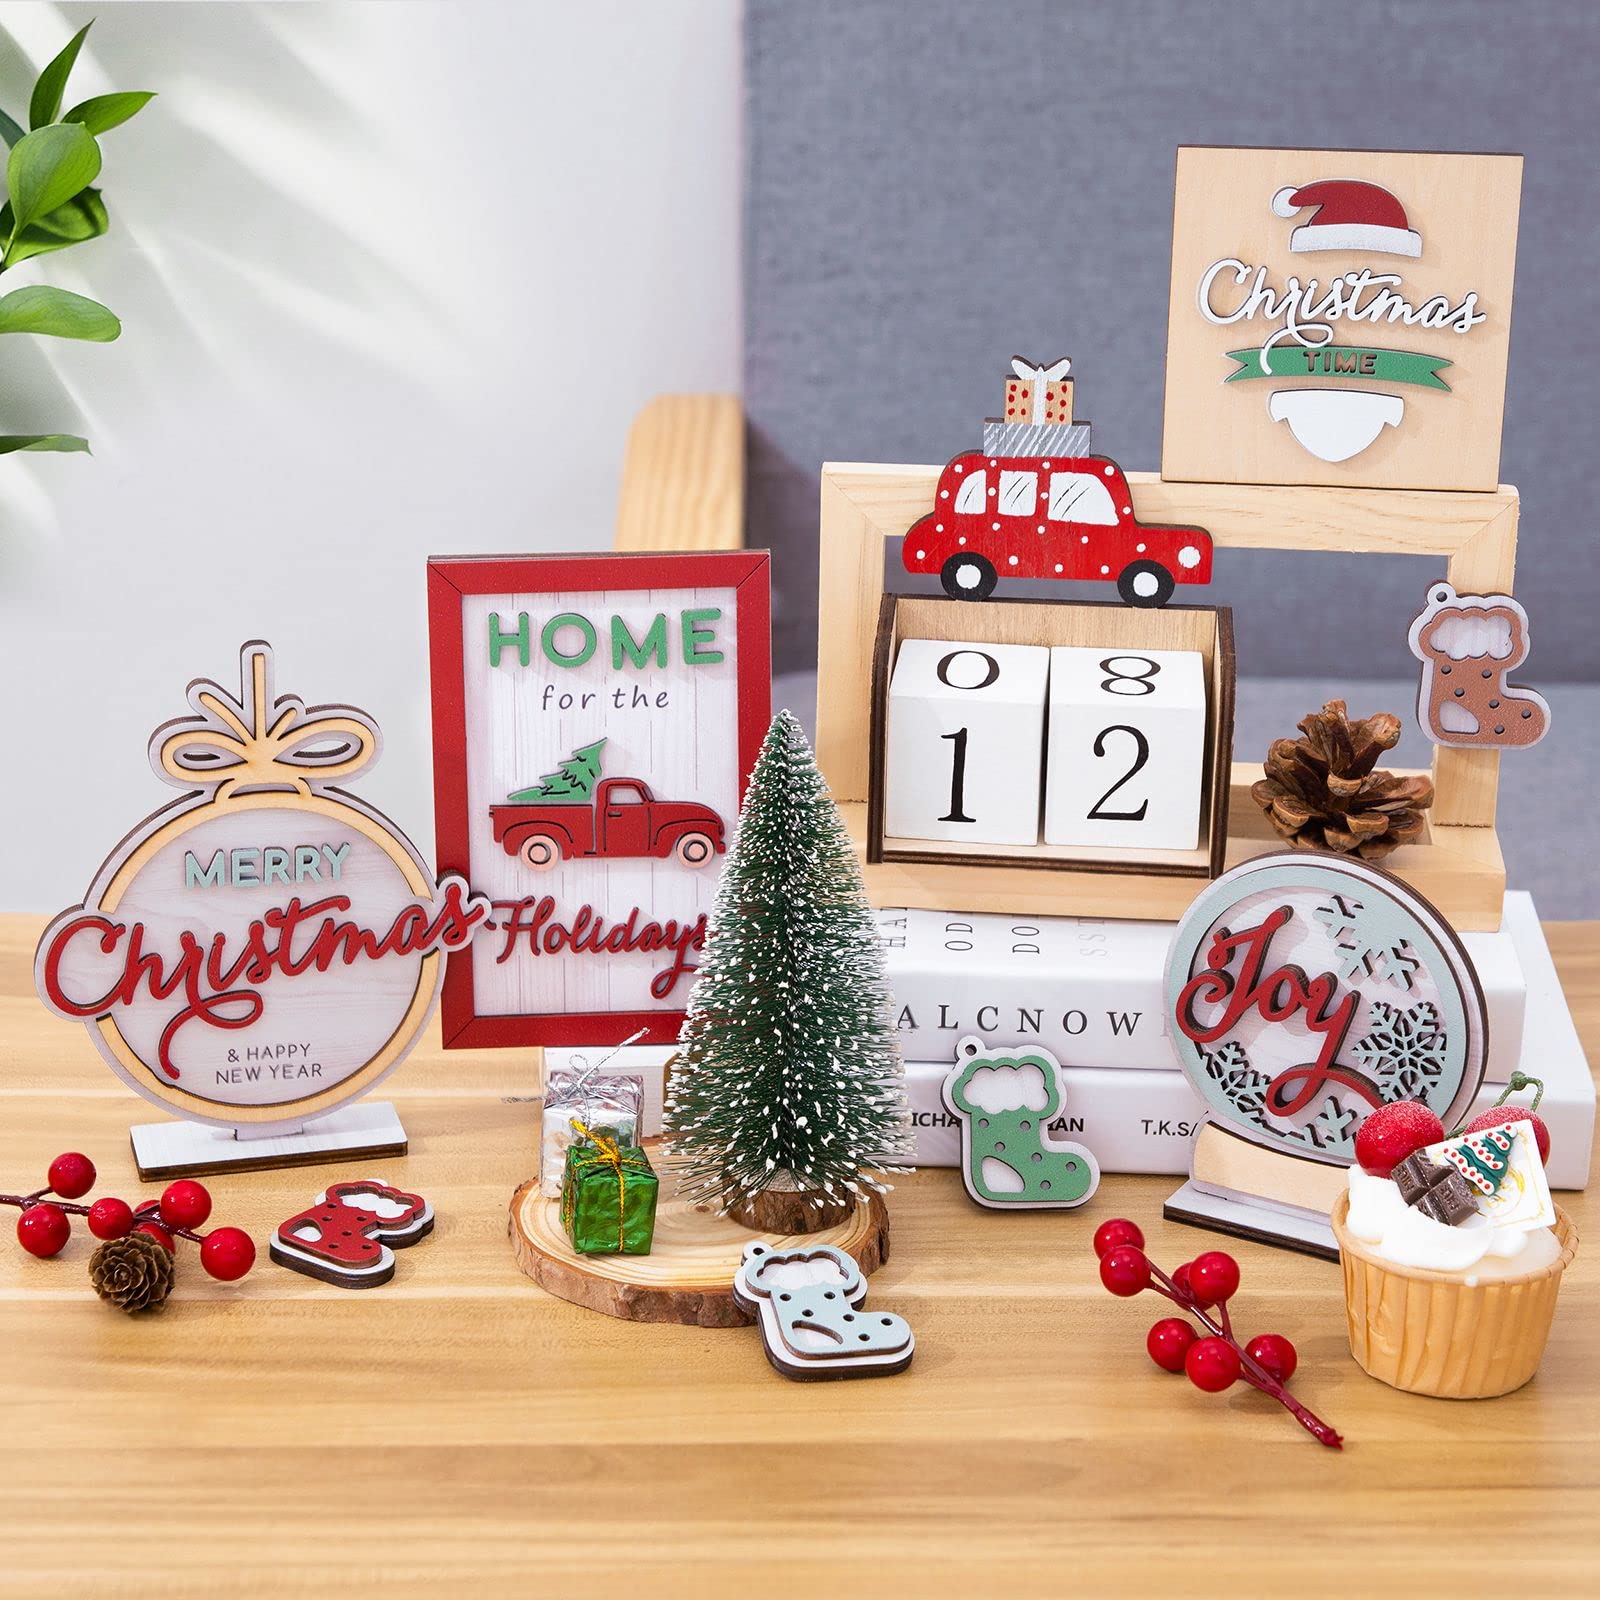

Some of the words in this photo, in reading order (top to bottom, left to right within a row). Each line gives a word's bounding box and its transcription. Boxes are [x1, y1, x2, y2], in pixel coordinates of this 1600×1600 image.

[1197, 257, 1487, 374] Christmas
[1302, 350, 1377, 375] TIME
[488, 608, 725, 670] HOME
[542, 684, 597, 711] for
[612, 685, 670, 709] the
[184, 842, 351, 889] MERRY
[44, 883, 485, 1079] Christmas
[1175, 905, 1388, 1117] Joy
[216, 1066, 261, 1085] NEW
[268, 1063, 322, 1080] YEAR
[227, 1048, 240, 1063] &
[247, 1043, 311, 1061] HAPPY
